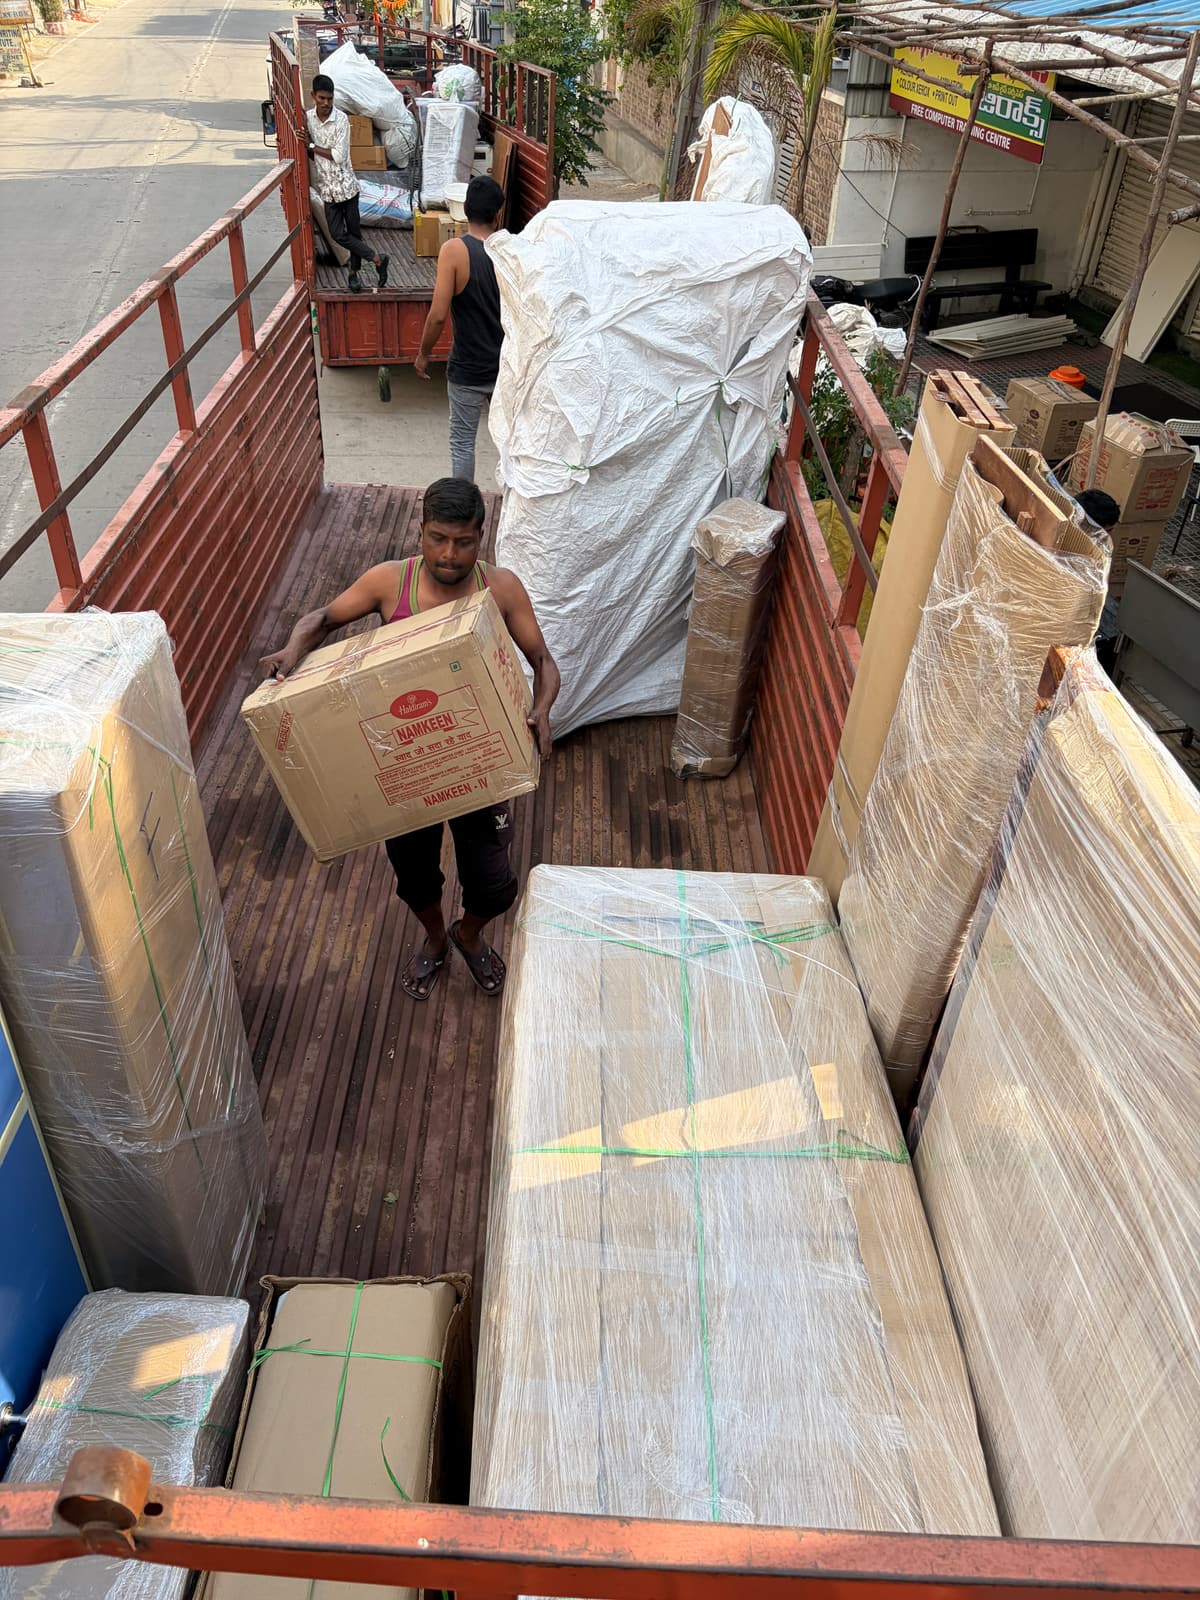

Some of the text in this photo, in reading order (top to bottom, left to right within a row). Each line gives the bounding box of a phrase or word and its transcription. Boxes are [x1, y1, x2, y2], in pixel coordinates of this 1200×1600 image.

[899, 78, 959, 107] COLOUR XEROX PRINT OUT
[911, 104, 924, 118] FREE
[924, 108, 955, 130] COMPUTER
[986, 131, 1011, 150] CENTRE
[397, 713, 454, 742] NAMKEEN
[414, 746, 425, 756] जो
[445, 737, 456, 746] रहे
[423, 782, 472, 807] NAMKEEN
[478, 777, 488, 790] IV
